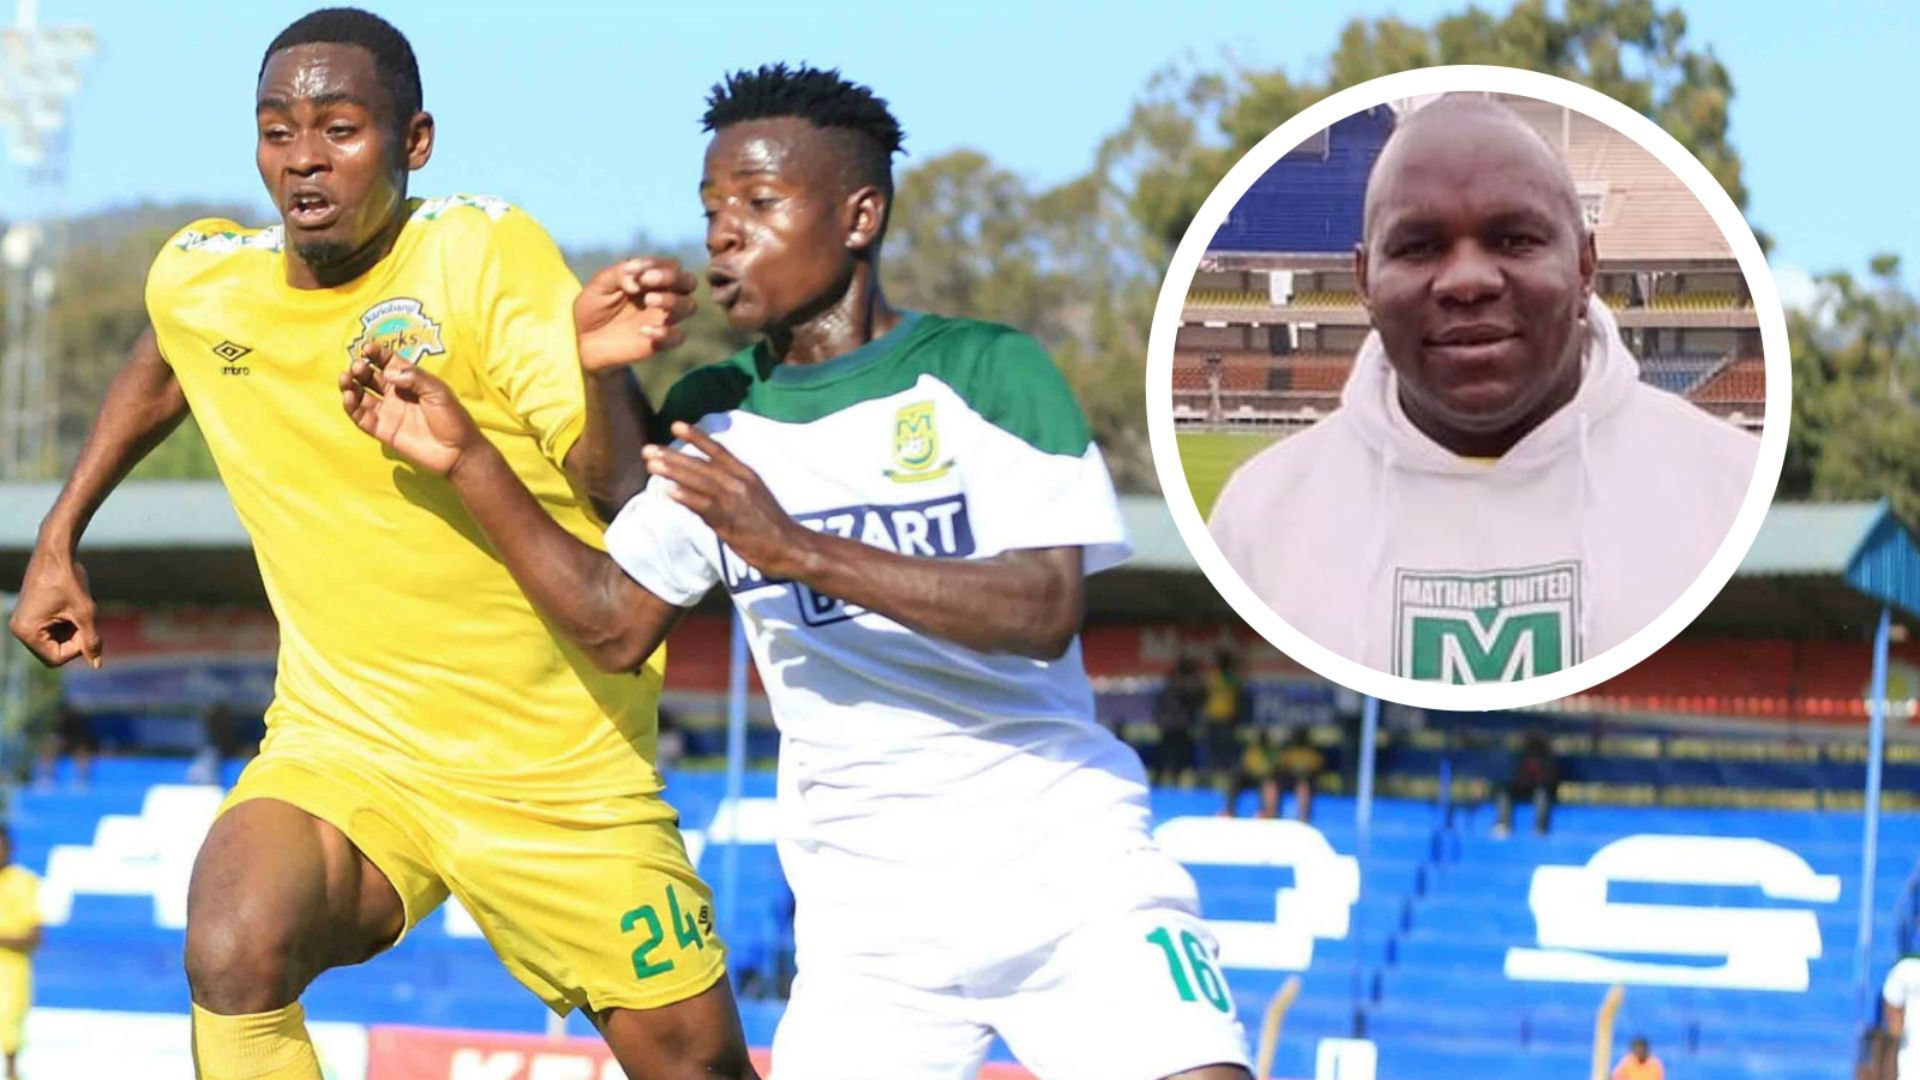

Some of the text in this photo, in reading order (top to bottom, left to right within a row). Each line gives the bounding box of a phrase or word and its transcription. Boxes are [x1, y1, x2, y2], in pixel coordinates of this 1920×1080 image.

[1402, 571, 1571, 608] MATHARE UNITED
[619, 883, 704, 980] 24
[1145, 926, 1230, 1013] 16
